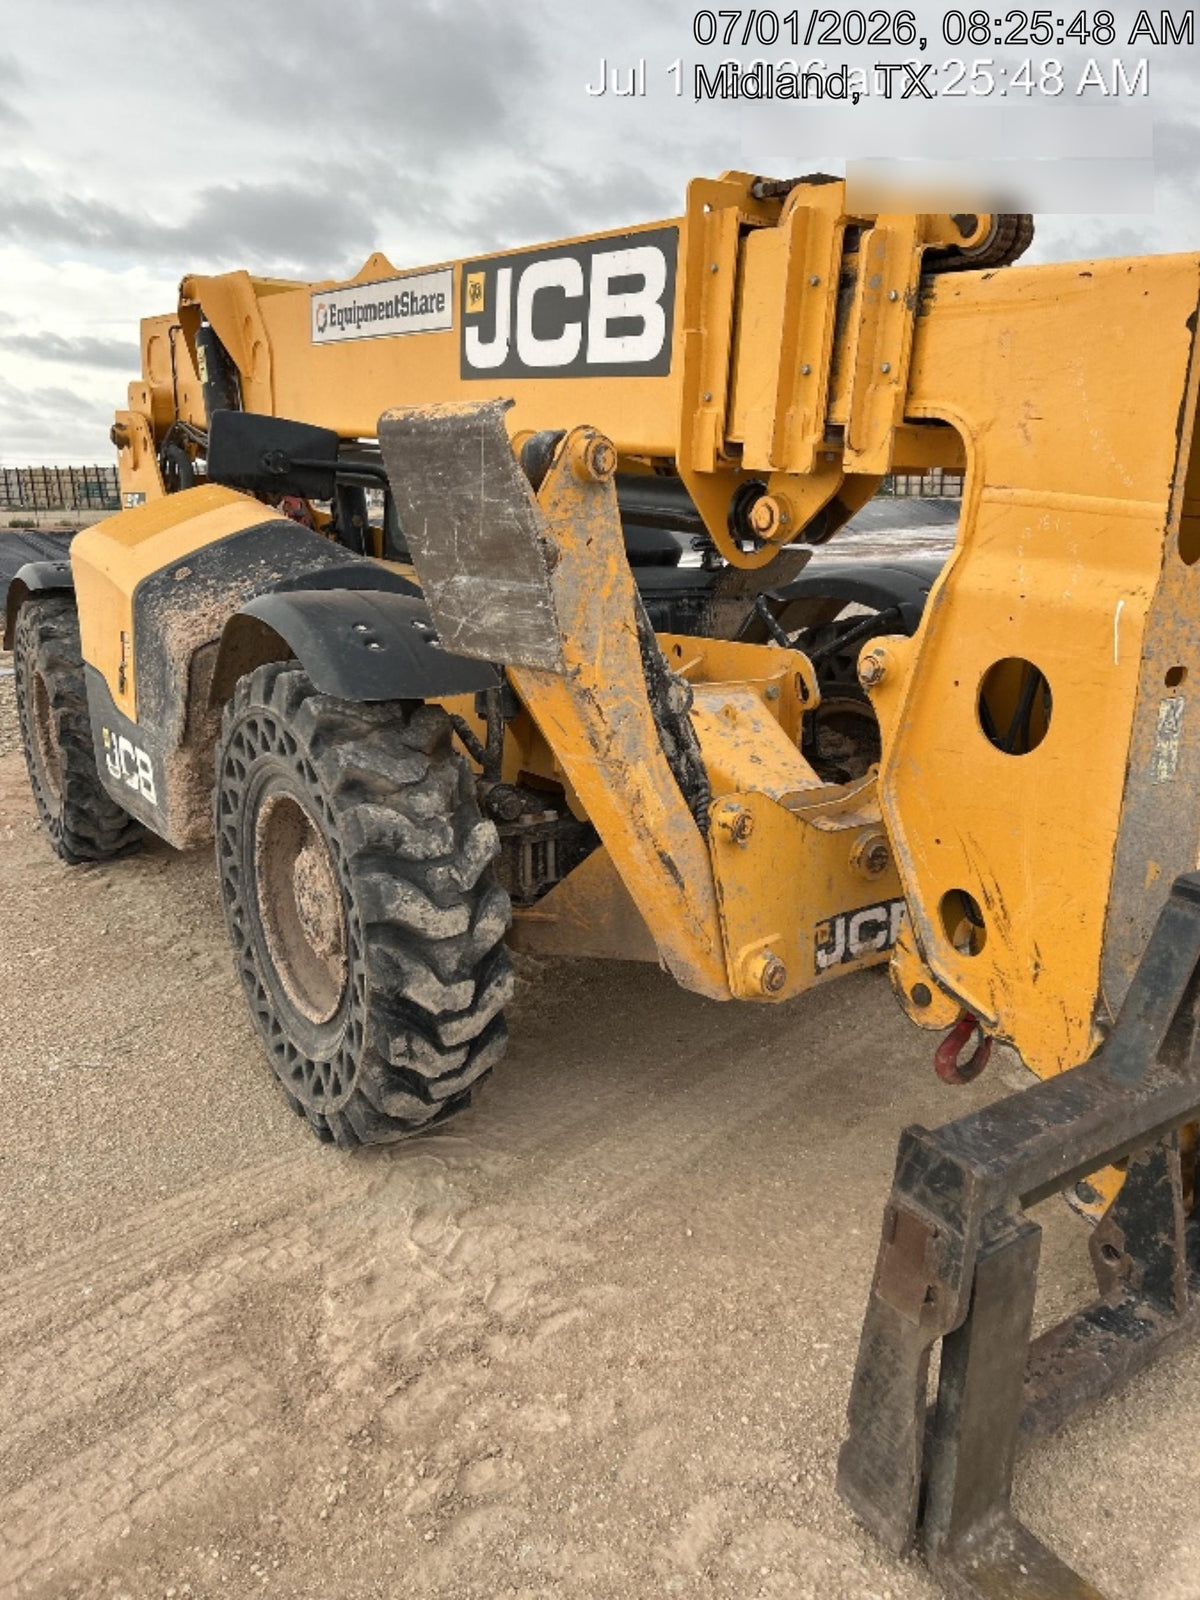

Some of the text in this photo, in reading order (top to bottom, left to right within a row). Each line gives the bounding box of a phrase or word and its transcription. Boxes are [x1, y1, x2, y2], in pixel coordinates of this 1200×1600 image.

[328, 289, 446, 331] EquipmentShare
[465, 246, 666, 369] JCB
[106, 731, 158, 806] JCB
